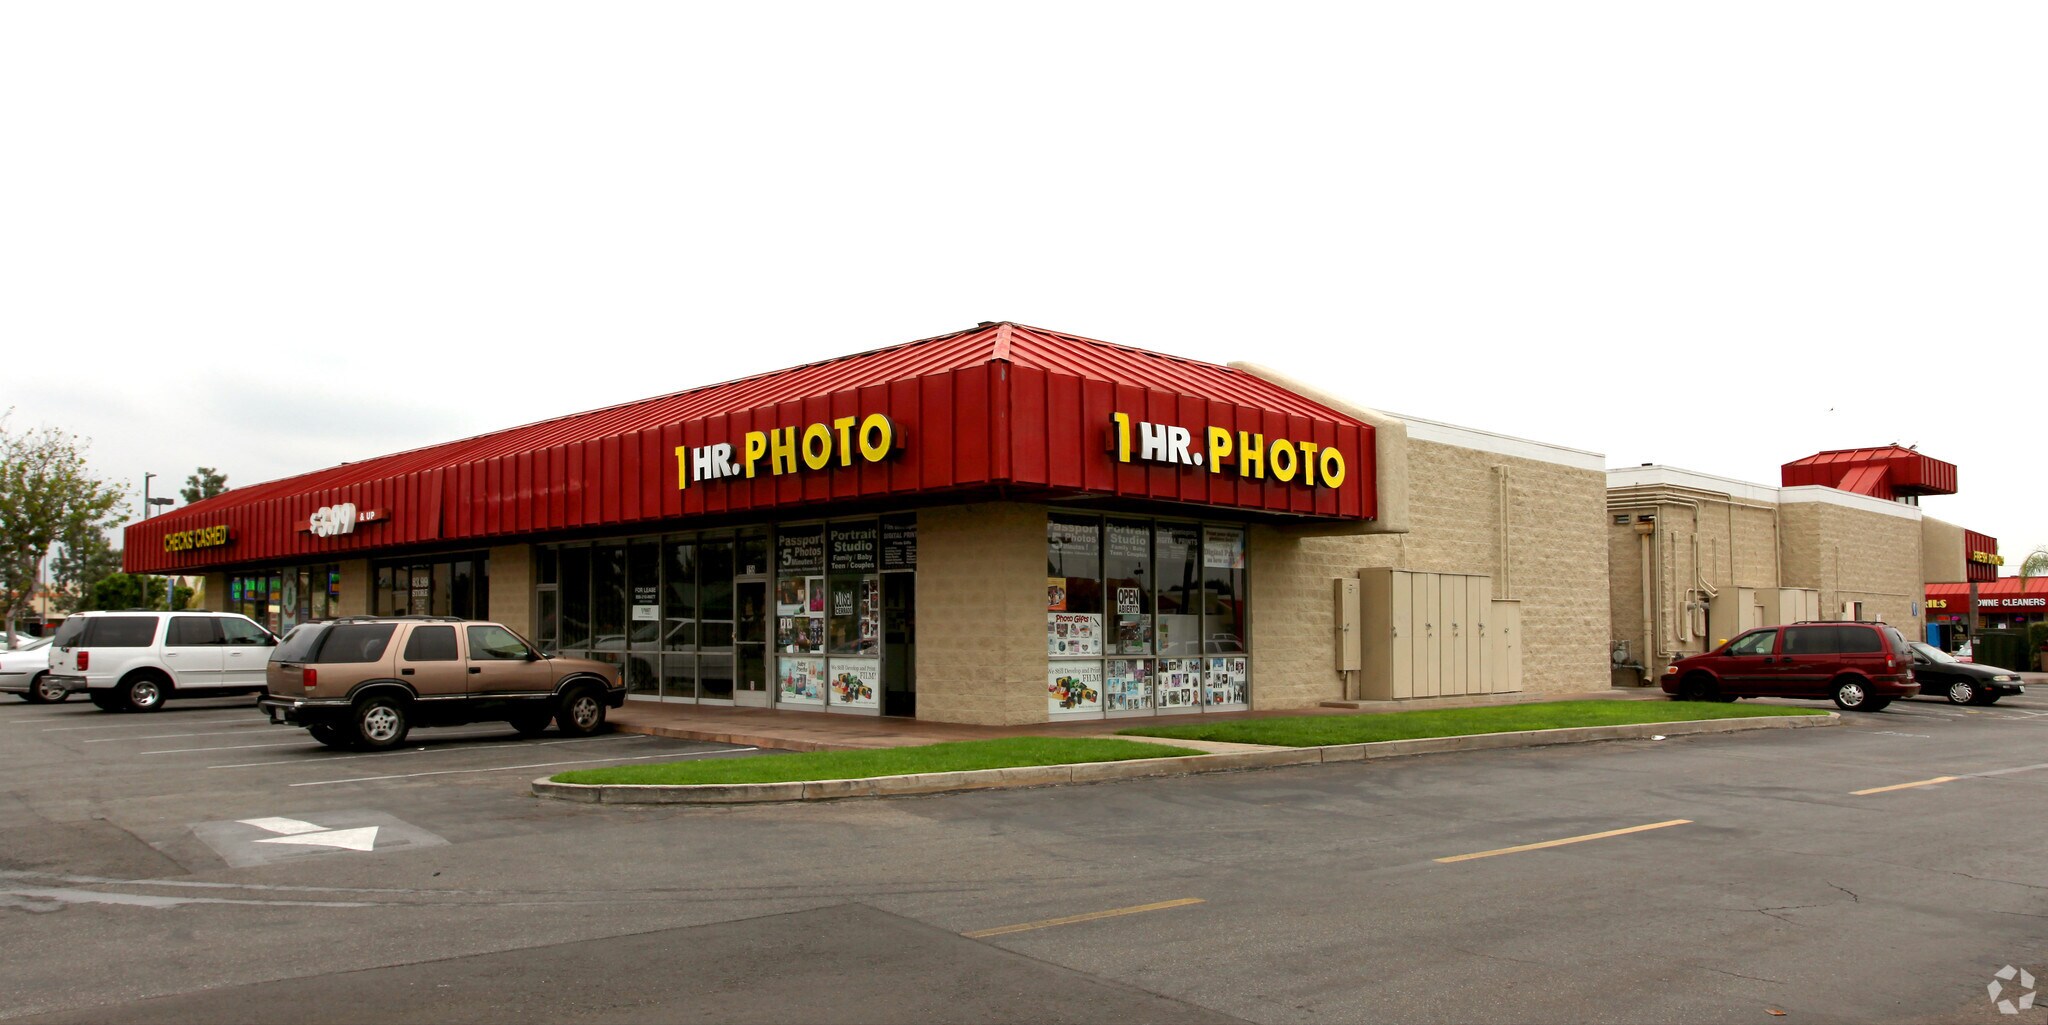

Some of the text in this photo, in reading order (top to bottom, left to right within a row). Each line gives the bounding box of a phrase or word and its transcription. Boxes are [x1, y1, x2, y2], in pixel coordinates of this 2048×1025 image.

[675, 412, 893, 490] 1 HR. PHOTO
[1113, 411, 1346, 489] 1 HR. PHOTO
[309, 502, 375, 538] $3.99 & UP
[1047, 520, 1099, 535] Passport
[1106, 523, 1150, 536] Portrait
[164, 525, 227, 552] CHECKS CASHED
[831, 528, 877, 540] Portrait
[1110, 533, 1146, 545] Studio
[778, 533, 824, 548] Passport
[834, 540, 873, 552] Studio
[1052, 532, 1096, 549] 5 Photos
[782, 546, 822, 566] 5 Photos
[832, 554, 853, 562] Family
[857, 553, 873, 561] Baby
[1973, 550, 1988, 563] FRESH
[850, 561, 875, 570] Couples
[411, 588, 429, 597] STORE
[1118, 588, 1139, 605] OPEN
[1926, 599, 1947, 608] ILS
[2002, 598, 2046, 607] CLEANERS
[1119, 605, 1139, 613] ABIERTO
[1056, 614, 1073, 623] Photo
[1065, 667, 1081, 675] Develop
